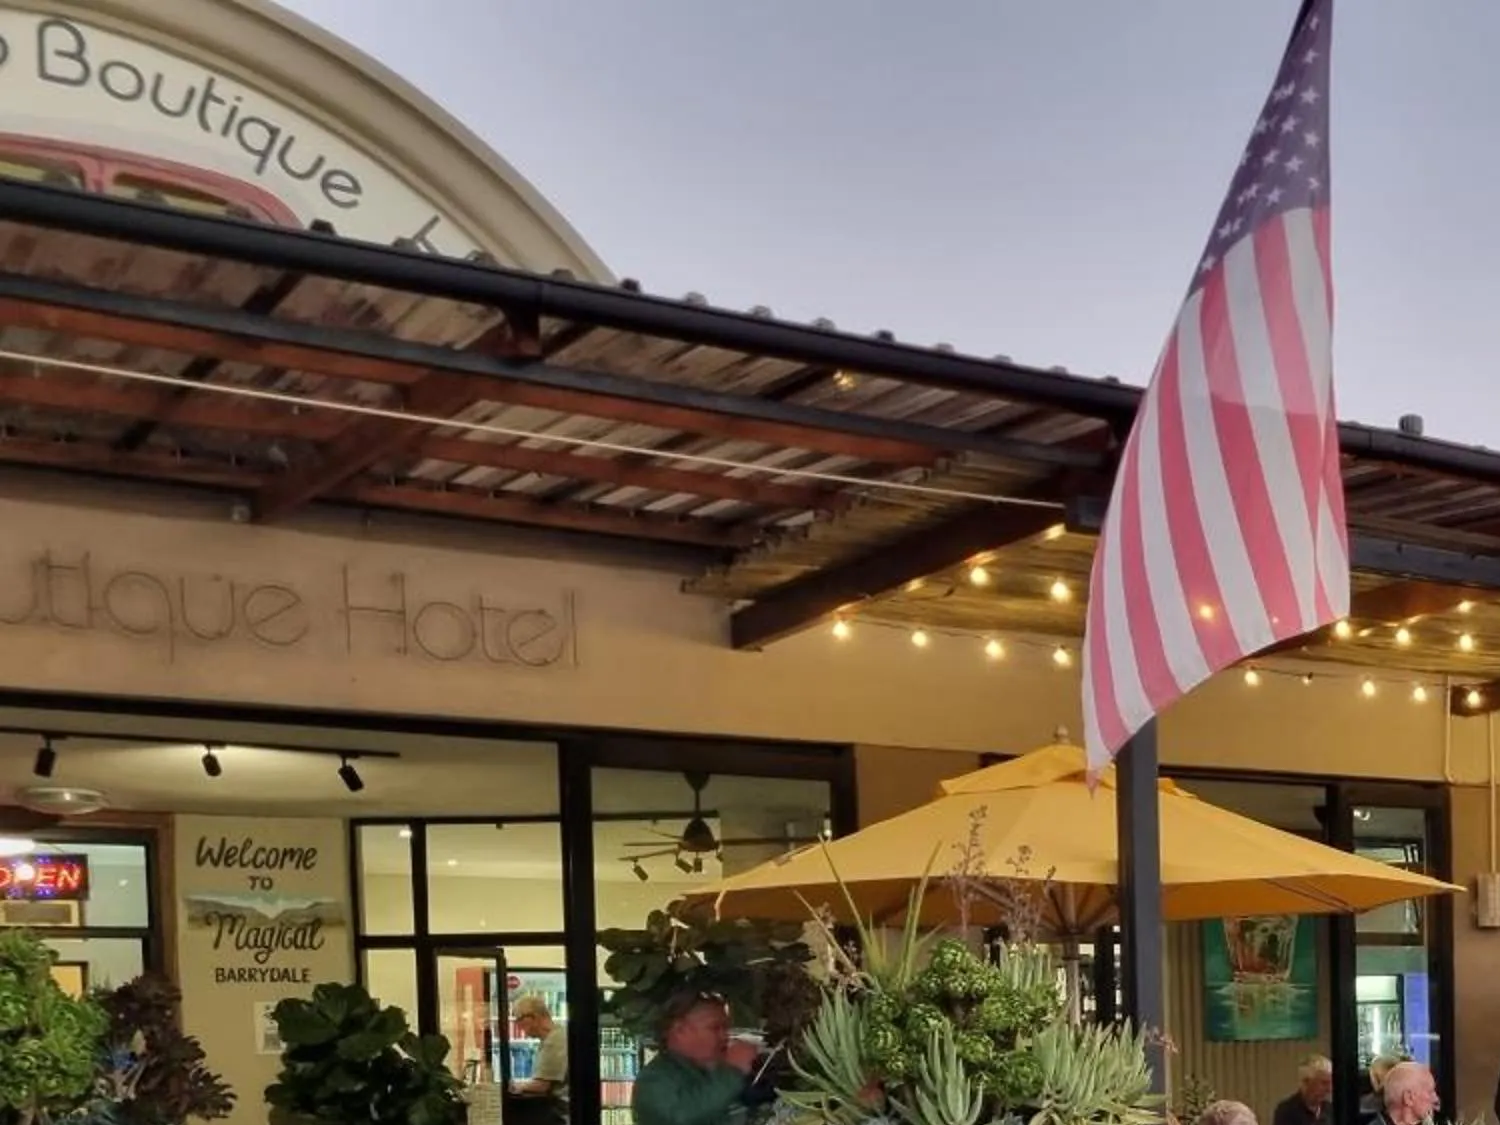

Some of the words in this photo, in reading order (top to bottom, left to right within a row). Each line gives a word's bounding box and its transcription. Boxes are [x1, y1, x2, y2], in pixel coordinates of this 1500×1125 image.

[37, 18, 363, 209] Boutique
[338, 563, 579, 669] Hotel
[195, 836, 318, 870] Welcome
[248, 875, 274, 891] TO
[204, 911, 326, 964] Magical
[215, 967, 312, 984] BARRYDALE
